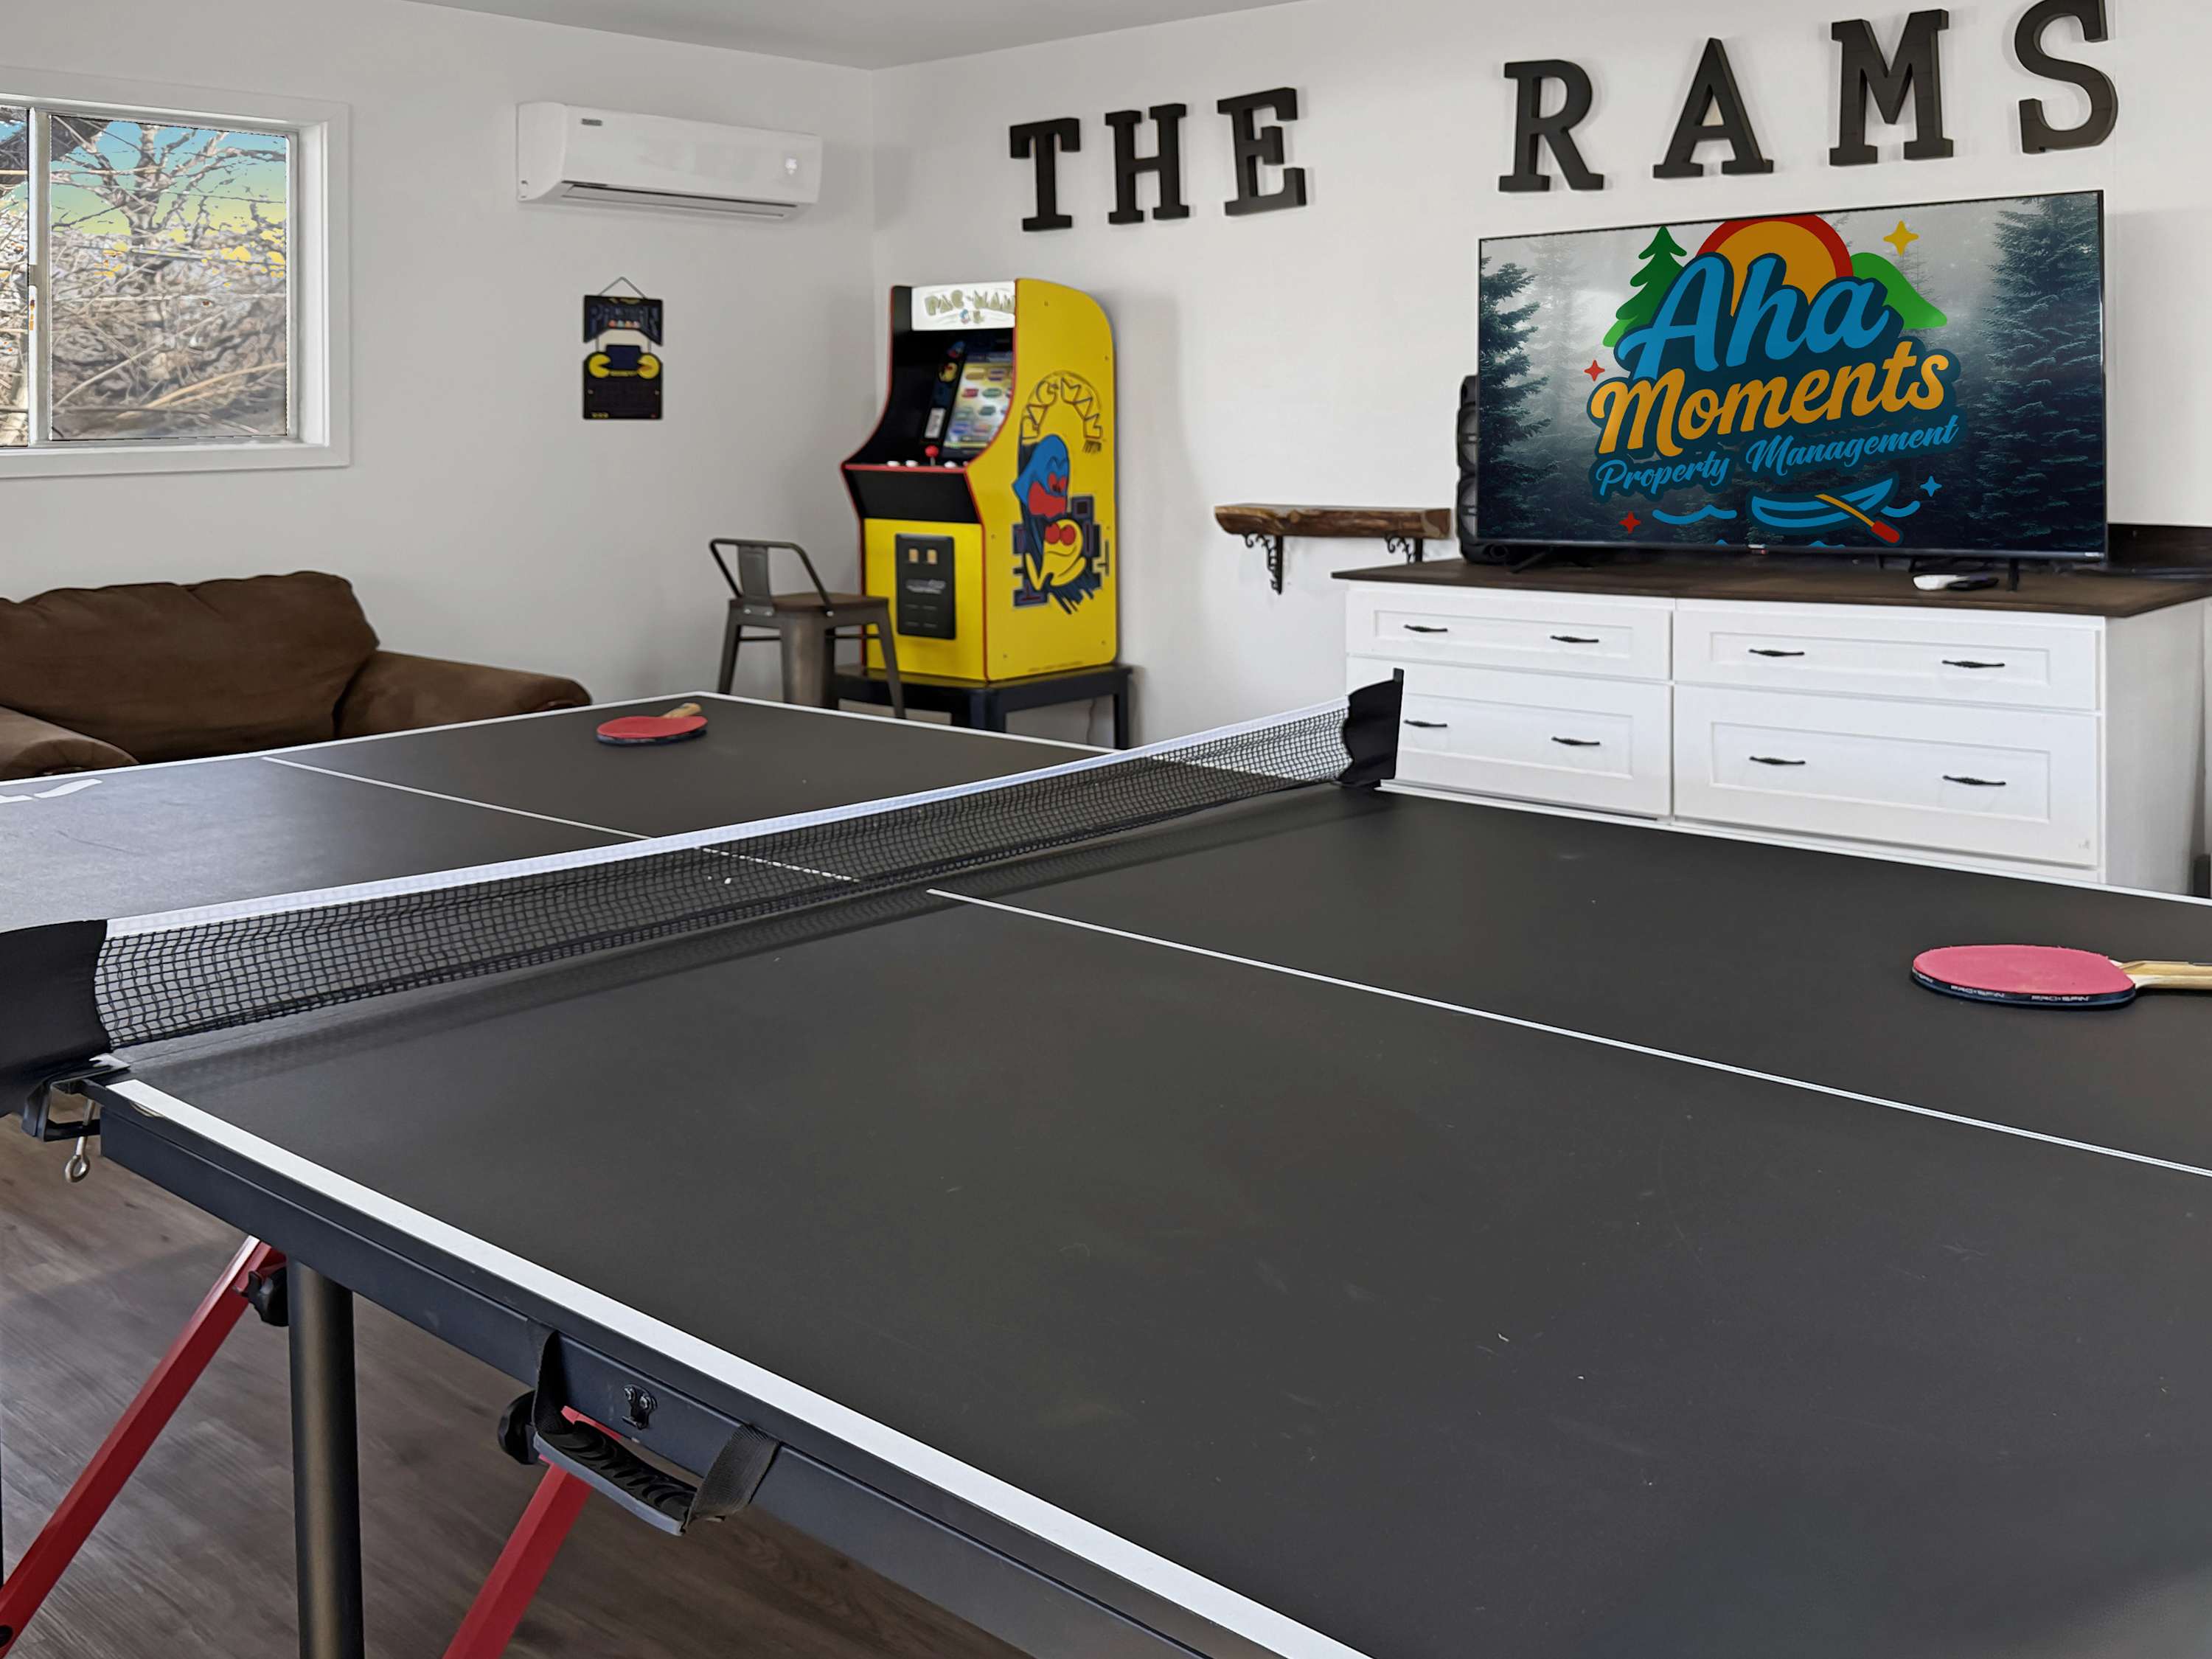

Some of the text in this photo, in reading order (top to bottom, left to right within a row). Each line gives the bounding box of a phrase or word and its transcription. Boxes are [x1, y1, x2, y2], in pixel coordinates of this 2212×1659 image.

[1009, 0, 2118, 232] THE RAMS
[1618, 256, 1890, 381] Aha
[1590, 341, 1949, 457] Moments
[1595, 414, 1959, 496] Property Management
